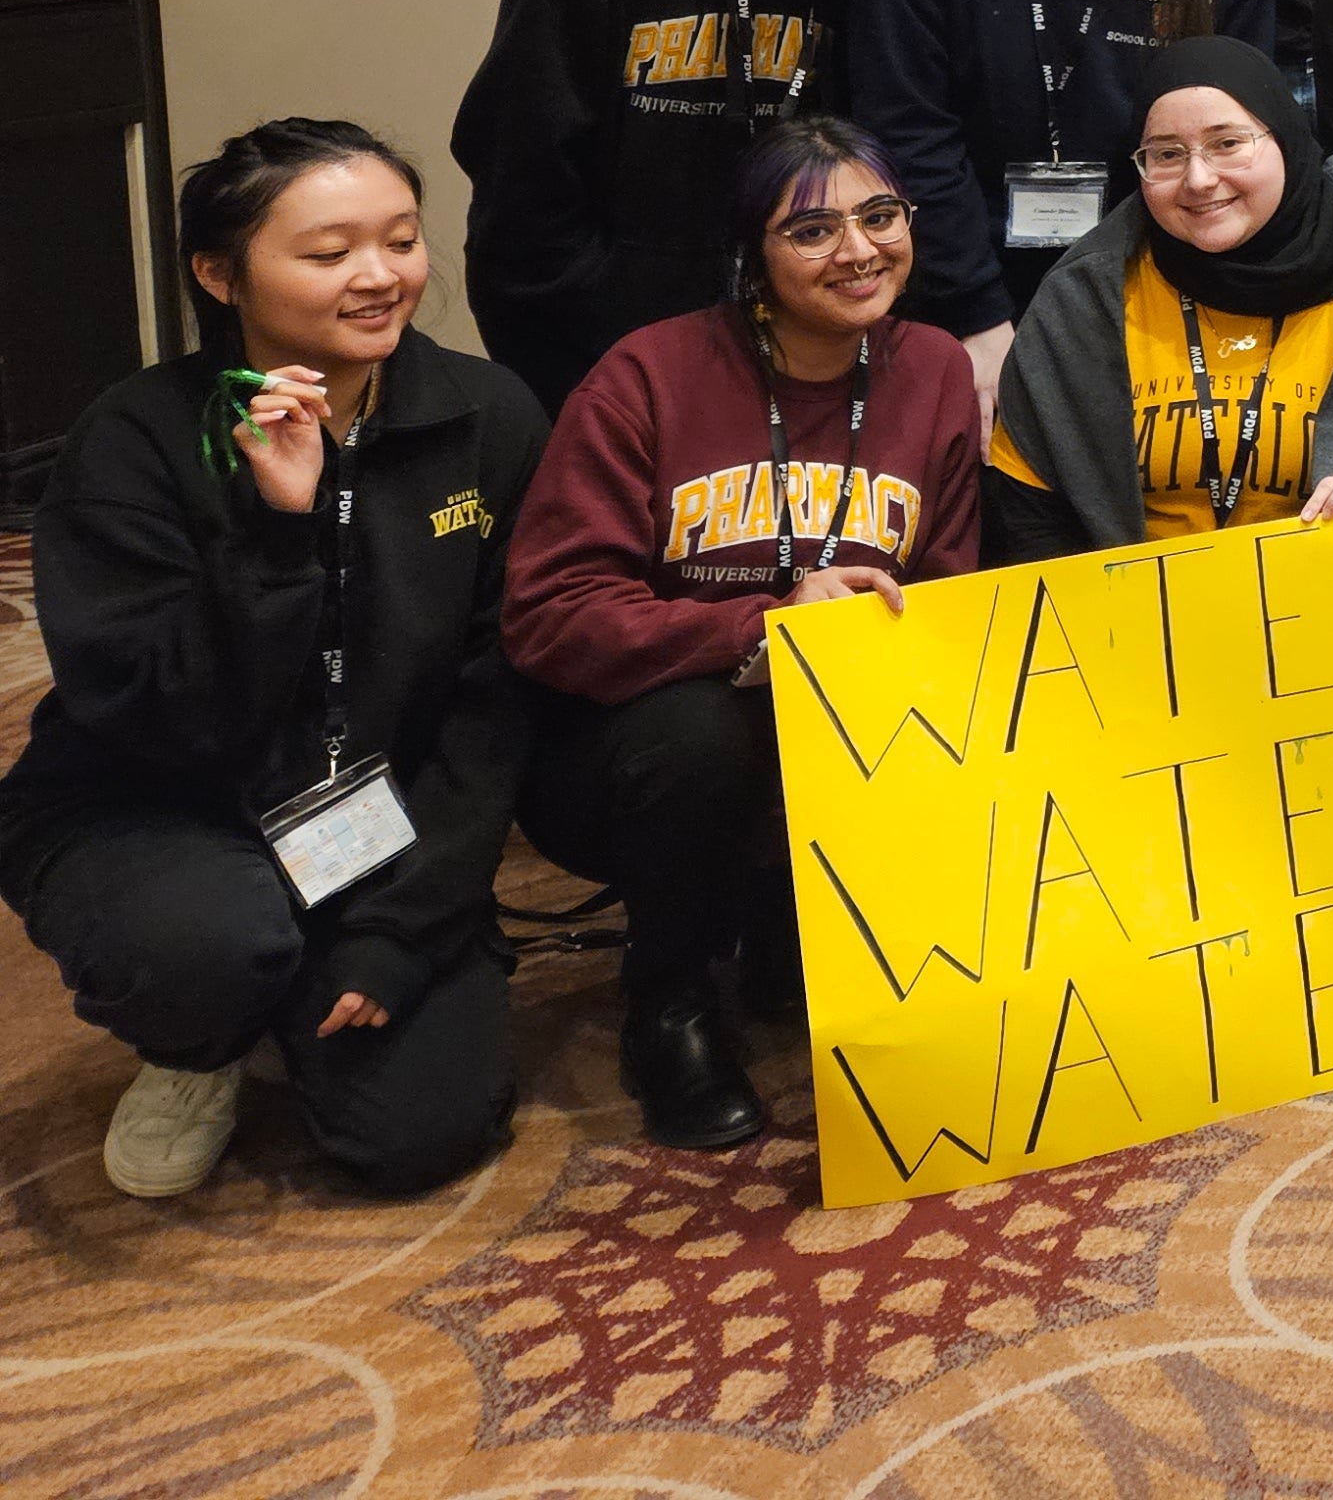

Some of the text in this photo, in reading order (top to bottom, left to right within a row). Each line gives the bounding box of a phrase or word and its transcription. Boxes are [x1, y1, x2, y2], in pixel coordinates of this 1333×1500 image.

[1032, 4, 1045, 30] PDW
[1079, 7, 1093, 34] PDW
[1106, 31, 1146, 46] SCHOOL
[743, 55, 753, 83] PDW
[789, 68, 806, 96] PDW
[1042, 65, 1054, 91] PDW
[630, 93, 726, 116] UNIVERSITY
[1190, 346, 1205, 373] PDW
[1296, 383, 1317, 402] OF
[852, 401, 864, 430] PDW
[1201, 409, 1215, 439] PDW
[1242, 410, 1257, 440] PDW
[345, 417, 361, 447] PDW
[1210, 478, 1220, 507] PDW
[1225, 478, 1241, 508] PDW
[339, 491, 352, 524] PDW
[663, 461, 921, 568] PHARMACY
[779, 535, 790, 568] PDW
[818, 535, 838, 568] PDW
[681, 565, 778, 582] UNIVERSIT
[331, 650, 342, 684] PDW
